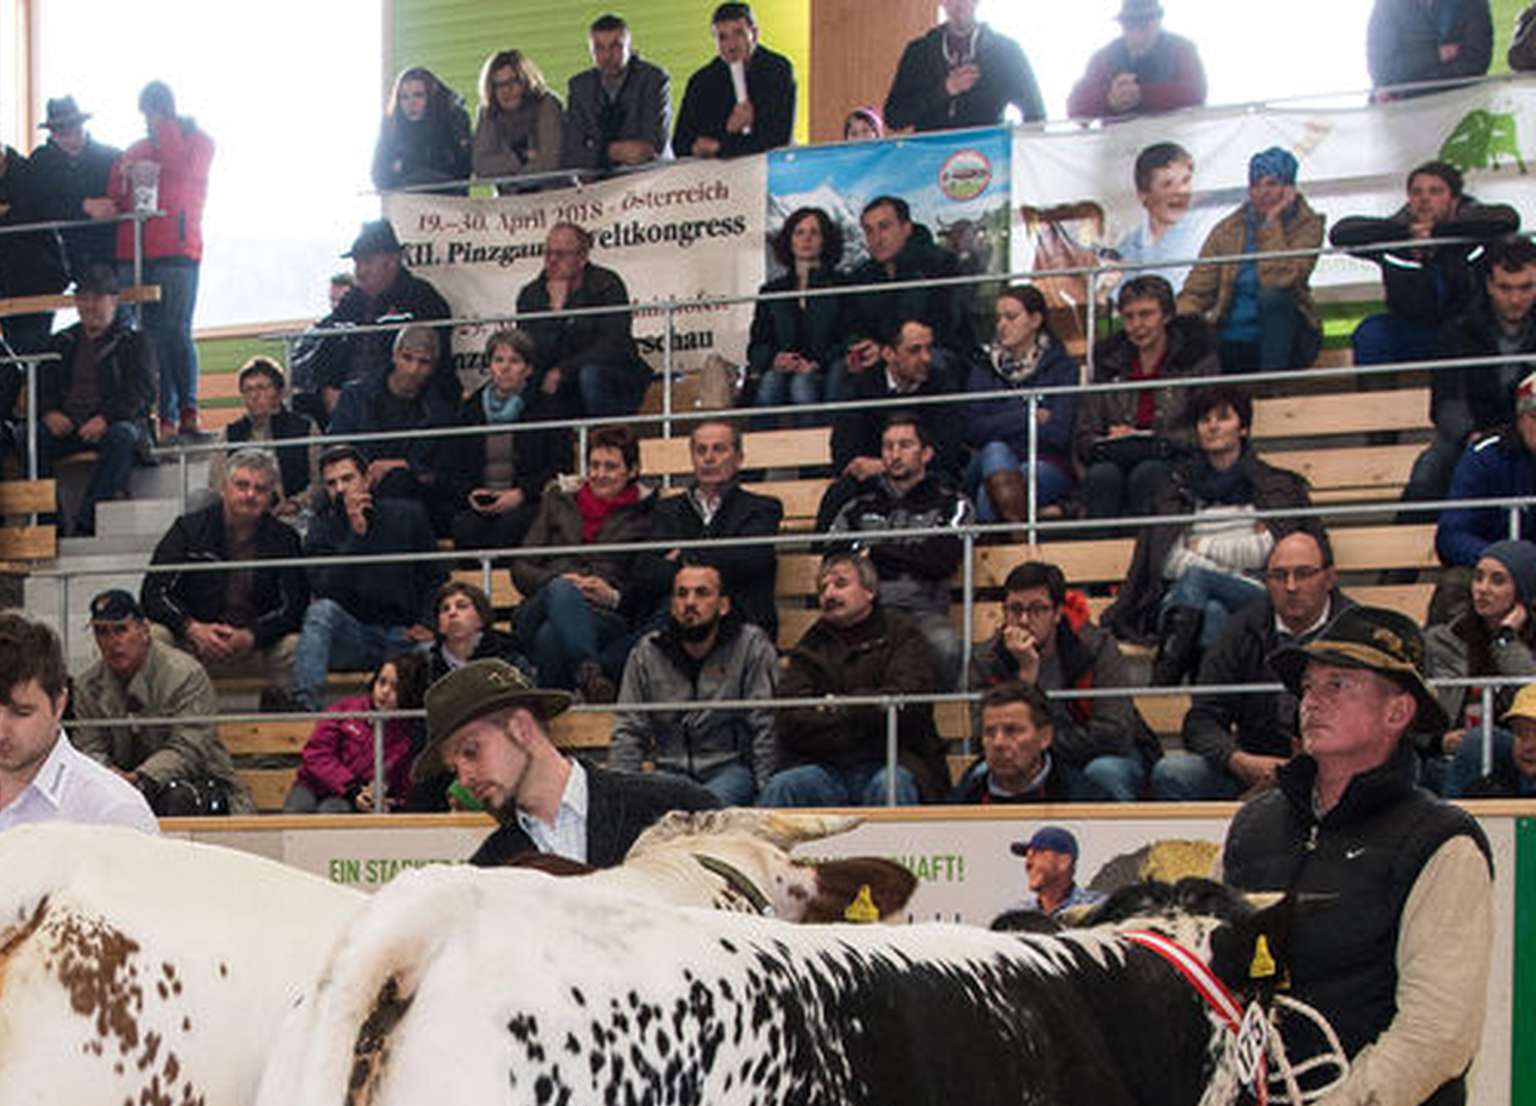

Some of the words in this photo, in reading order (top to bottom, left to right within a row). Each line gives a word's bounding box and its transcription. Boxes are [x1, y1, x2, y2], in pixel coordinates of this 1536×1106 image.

[496, 208, 546, 235] April
[552, 201, 604, 226] 2018
[448, 240, 547, 268] Pinzgau
[330, 859, 360, 883] EIN
